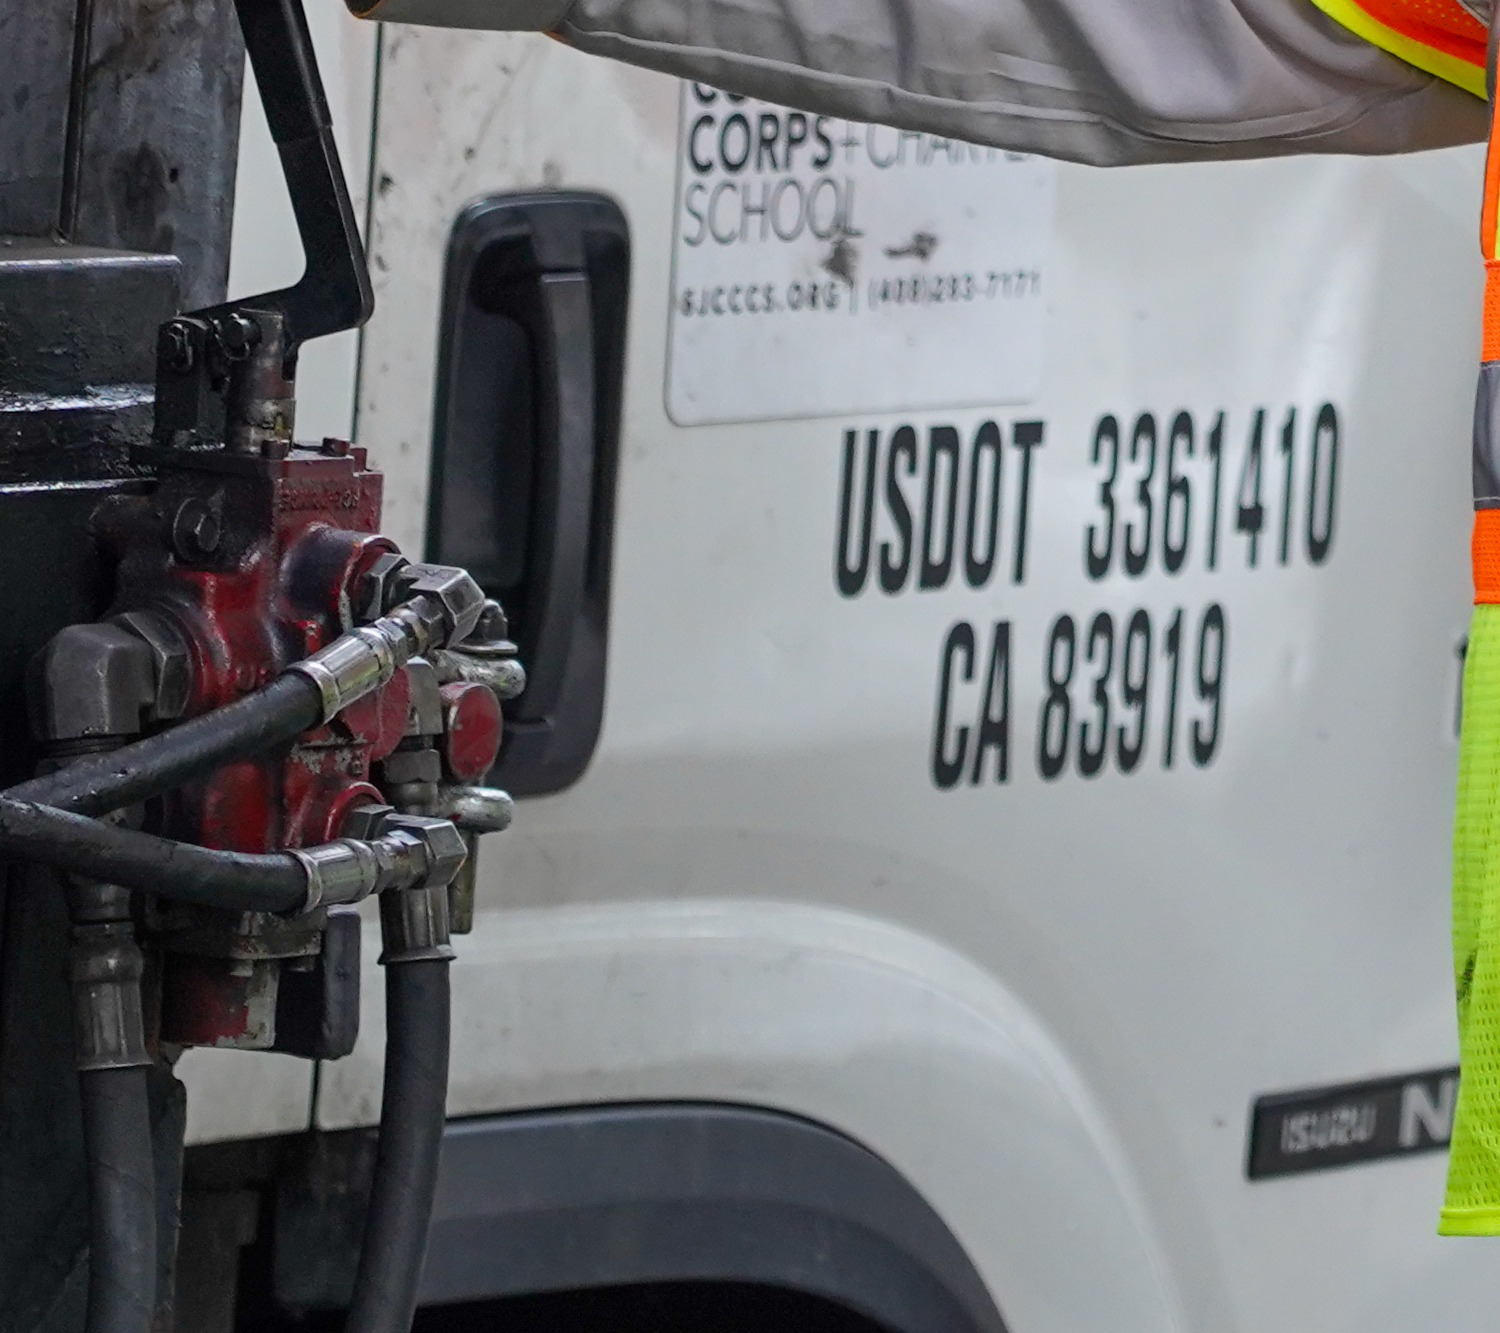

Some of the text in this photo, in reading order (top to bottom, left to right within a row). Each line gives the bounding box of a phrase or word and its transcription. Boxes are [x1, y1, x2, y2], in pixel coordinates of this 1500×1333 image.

[682, 178, 862, 246] SCHOOL
[835, 402, 1340, 598] USDOT 3361410
[930, 603, 1228, 790] CA 83919
[1280, 1102, 1377, 1154] ISUZU
